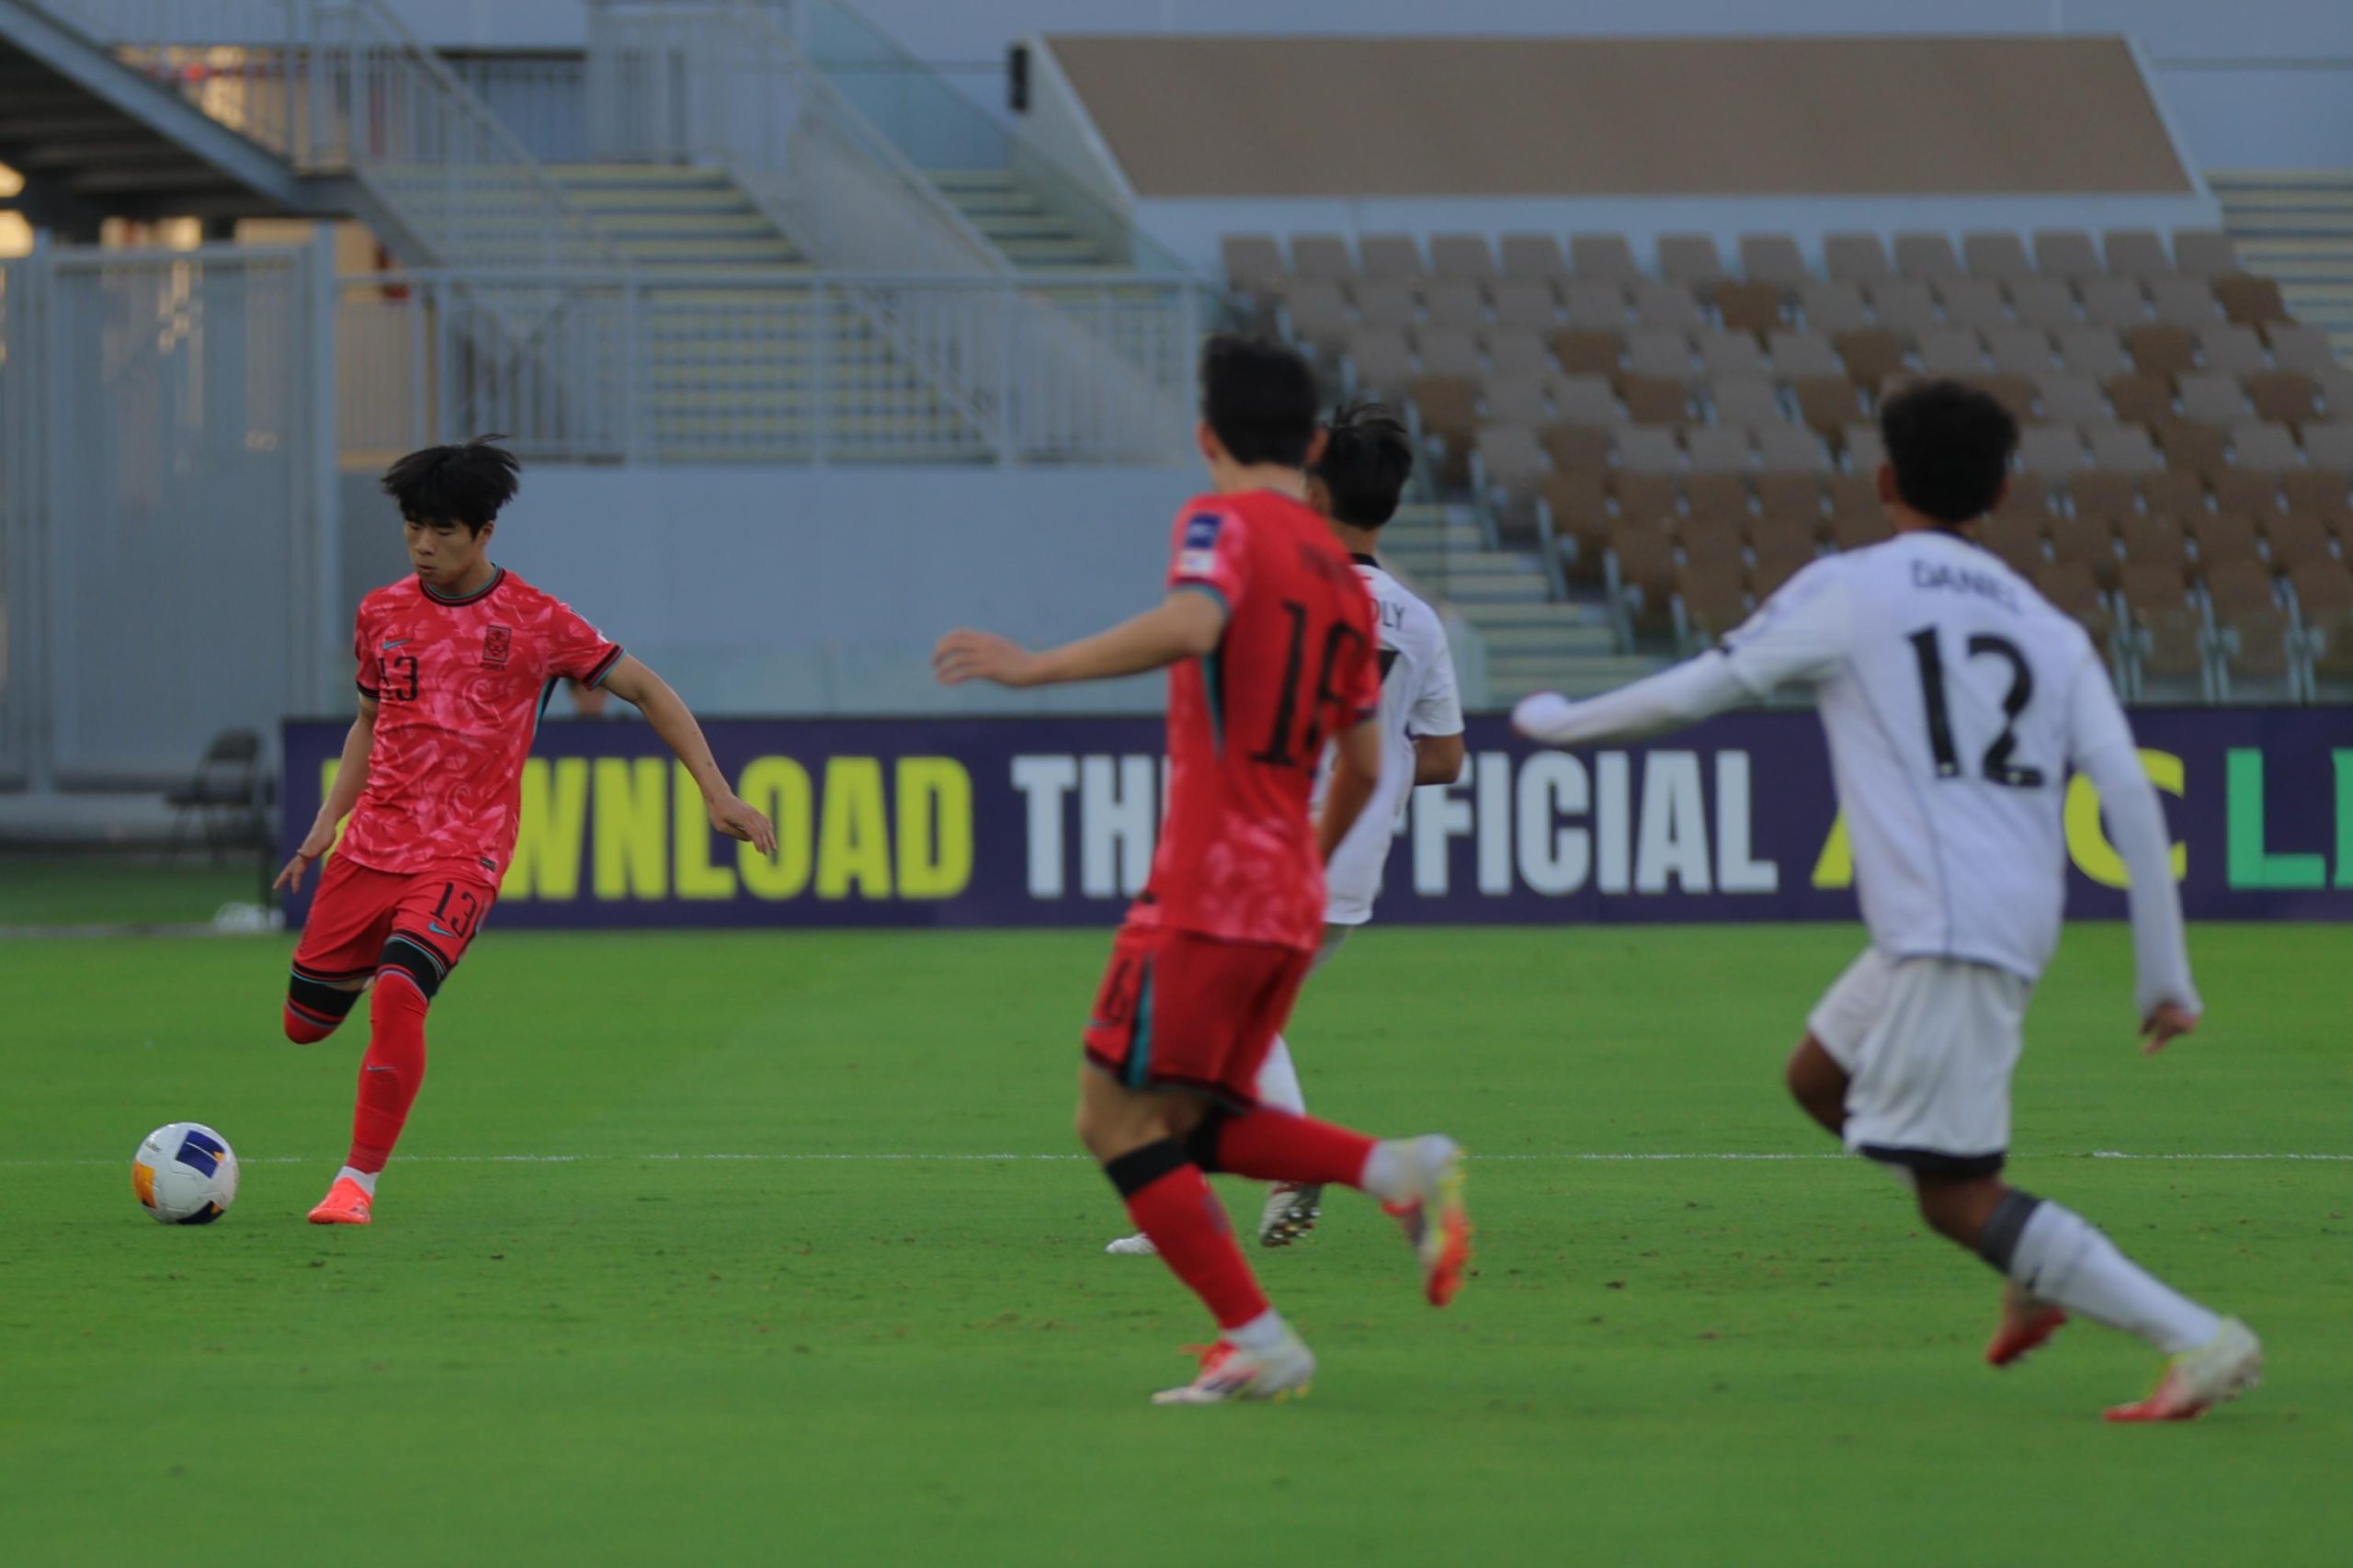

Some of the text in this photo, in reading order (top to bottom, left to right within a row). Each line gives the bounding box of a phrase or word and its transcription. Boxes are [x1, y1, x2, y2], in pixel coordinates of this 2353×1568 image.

[378, 655, 419, 701] 13
[1905, 625, 2044, 788] 12
[322, 756, 974, 902] WNLOAD
[1012, 754, 1168, 899] TH
[1392, 749, 1779, 897] FICIAL
[428, 882, 478, 939] 13
